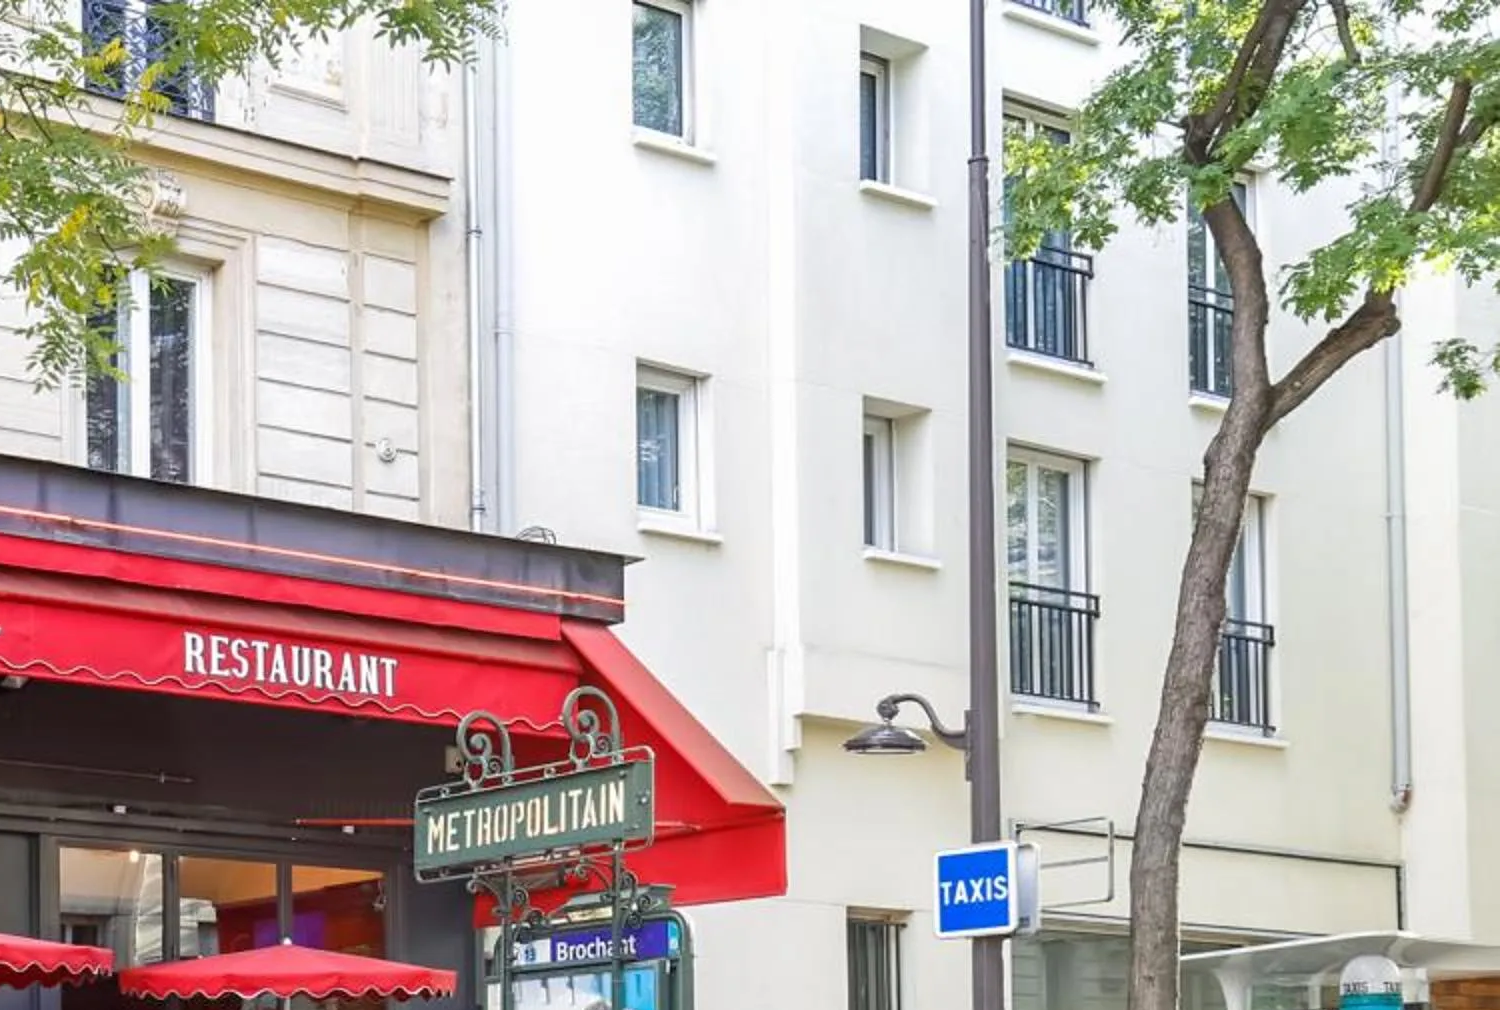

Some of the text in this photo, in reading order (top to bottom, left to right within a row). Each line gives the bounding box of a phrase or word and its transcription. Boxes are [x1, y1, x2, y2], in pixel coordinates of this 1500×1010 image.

[184, 631, 398, 697] RESTAURANT
[427, 779, 627, 855] METROPOLITAIN
[940, 874, 1009, 906] TAXIS
